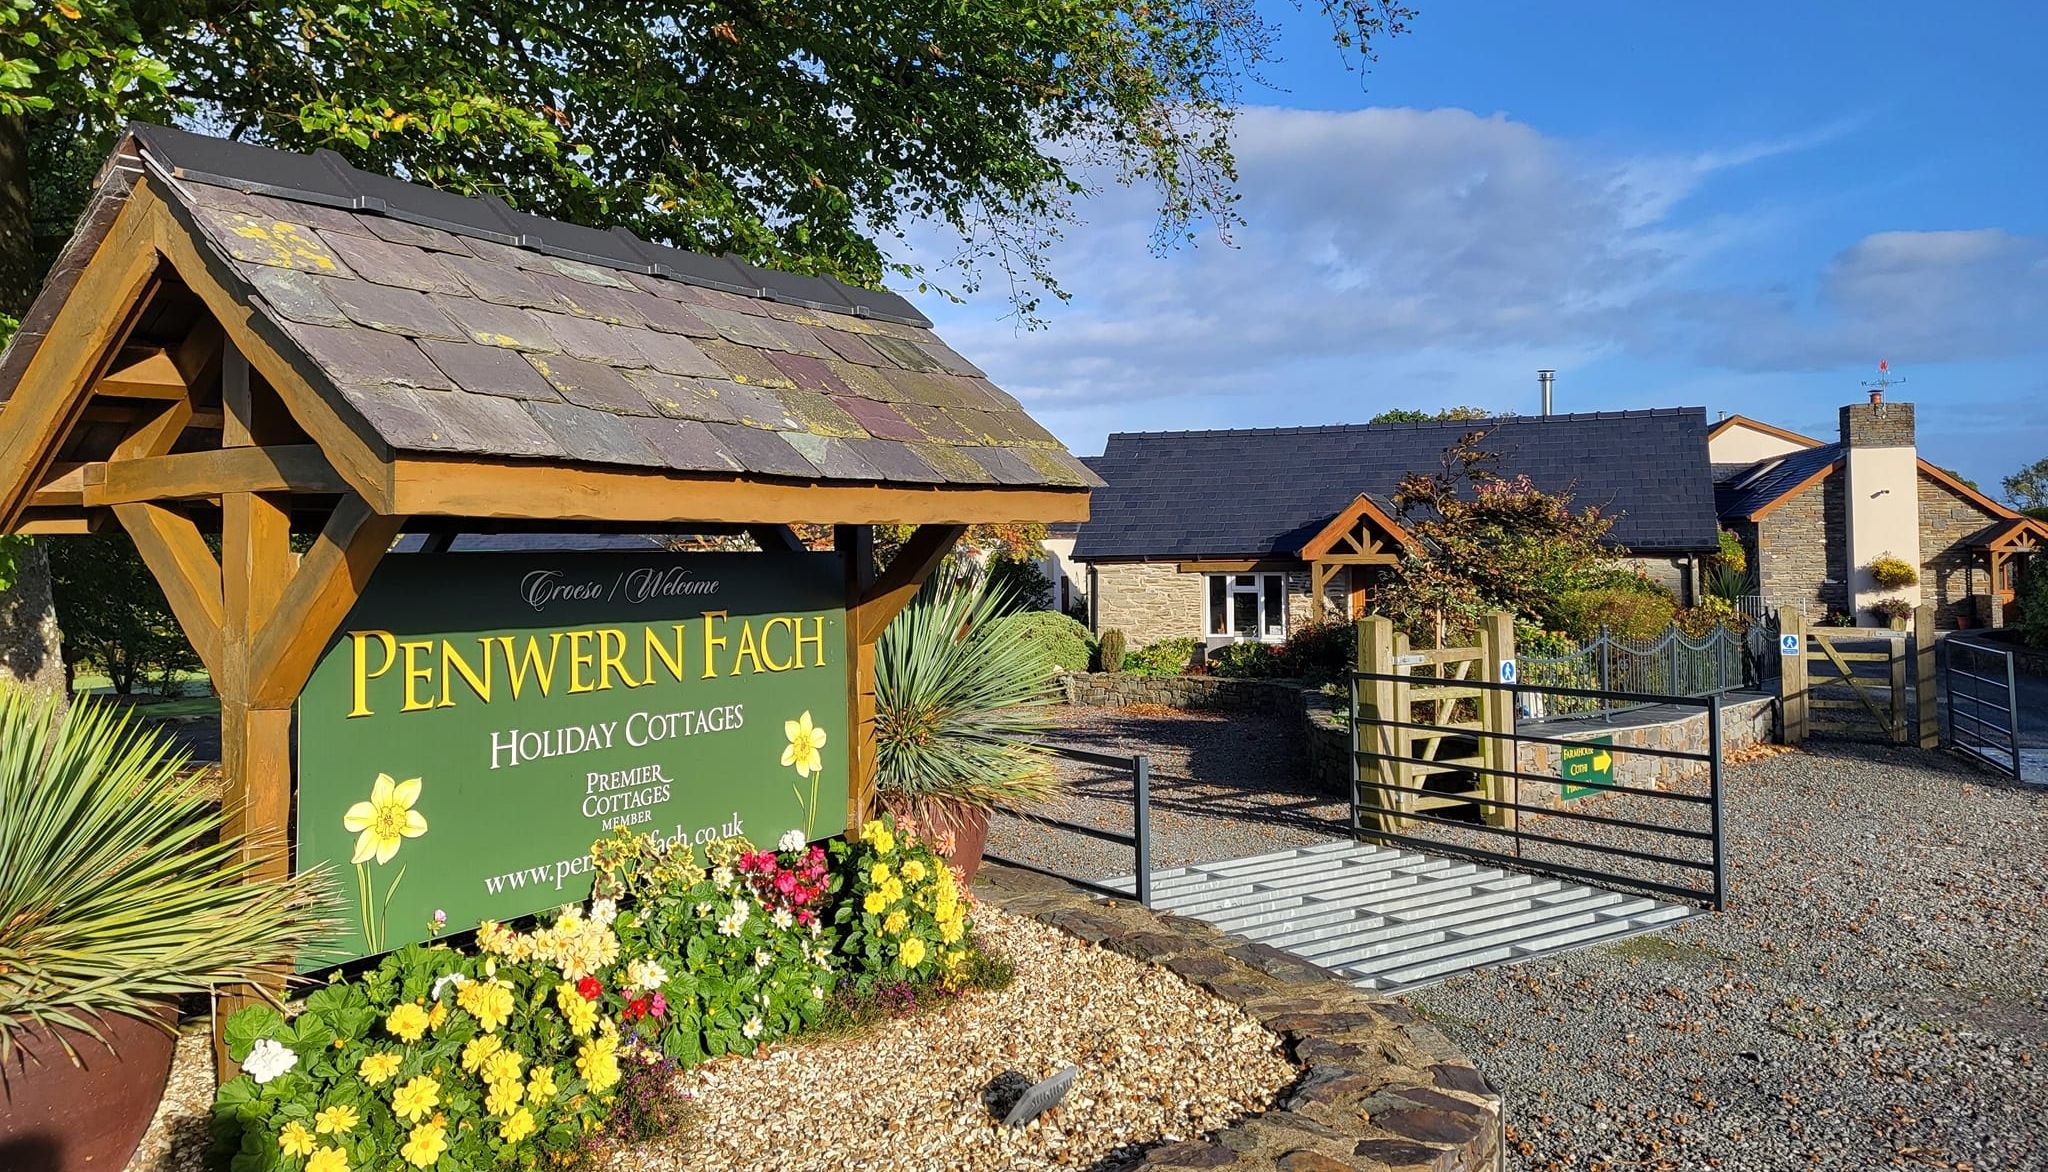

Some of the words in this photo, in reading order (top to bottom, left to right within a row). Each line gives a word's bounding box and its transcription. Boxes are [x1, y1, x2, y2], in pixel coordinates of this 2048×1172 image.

[520, 570, 603, 612] Croeso
[625, 566, 720, 604] Welcome
[346, 624, 687, 718] PENWERN
[700, 610, 826, 680] FACH
[489, 721, 618, 769] HOLIDAY
[625, 704, 744, 747] COTTAGES
[582, 784, 670, 818] COTTAGES
[586, 764, 674, 794] PREMIER
[601, 810, 652, 831] MEMBER
[484, 811, 744, 896] www.penfach.co.uk
